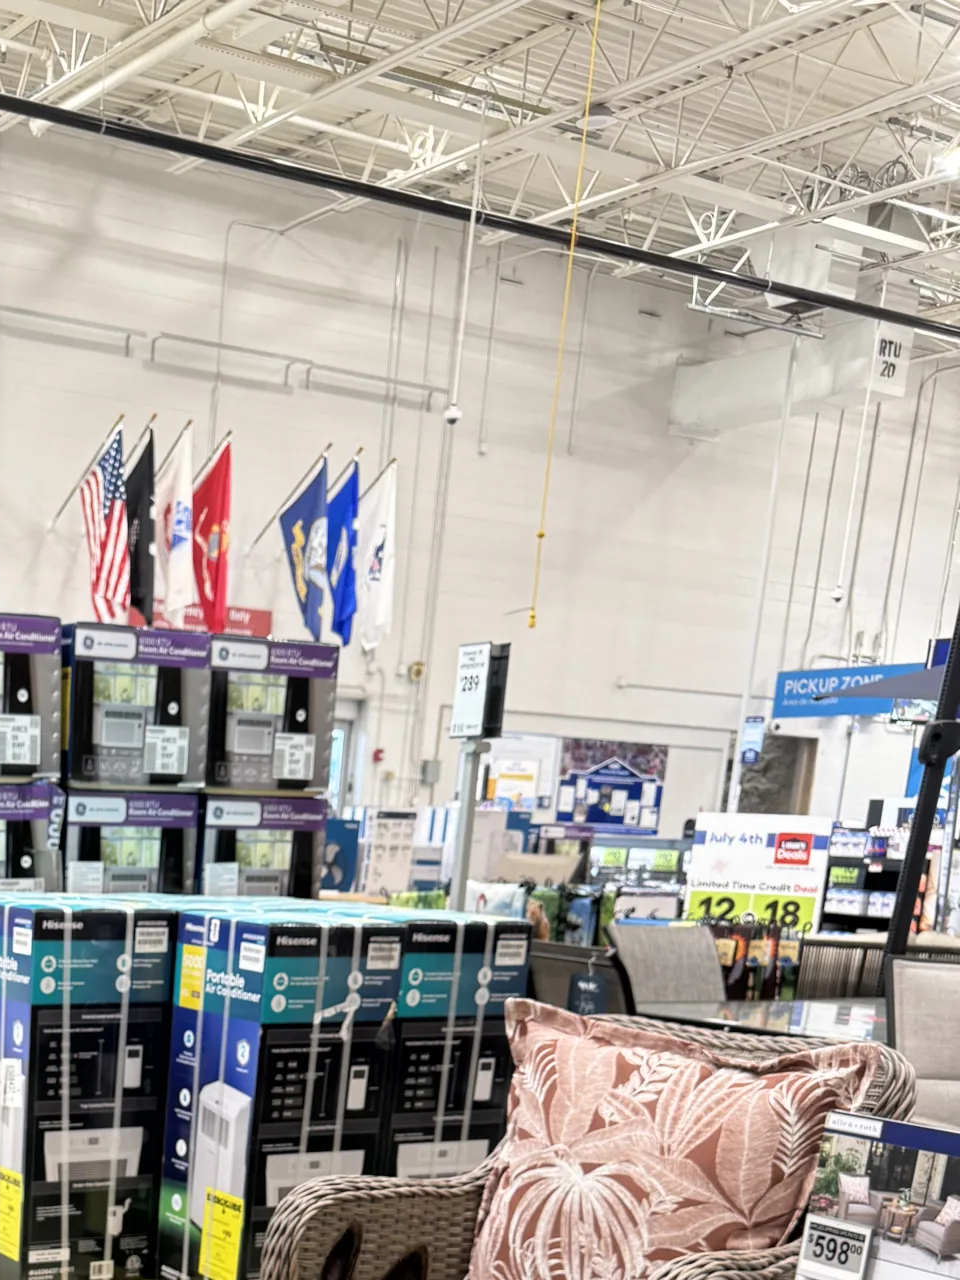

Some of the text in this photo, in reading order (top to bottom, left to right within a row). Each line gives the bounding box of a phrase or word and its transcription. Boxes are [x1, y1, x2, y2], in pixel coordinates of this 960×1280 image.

[879, 339, 902, 358] RTU
[880, 361, 896, 378] 20
[784, 676, 838, 695] PICKUP
[710, 832, 735, 846] July
[776, 850, 808, 861] Deals
[732, 880, 756, 890] Time
[698, 896, 800, 928] 12 18
[42, 919, 84, 931] Hisense
[276, 935, 318, 947] Hisense
[206, 968, 246, 988] Portable
